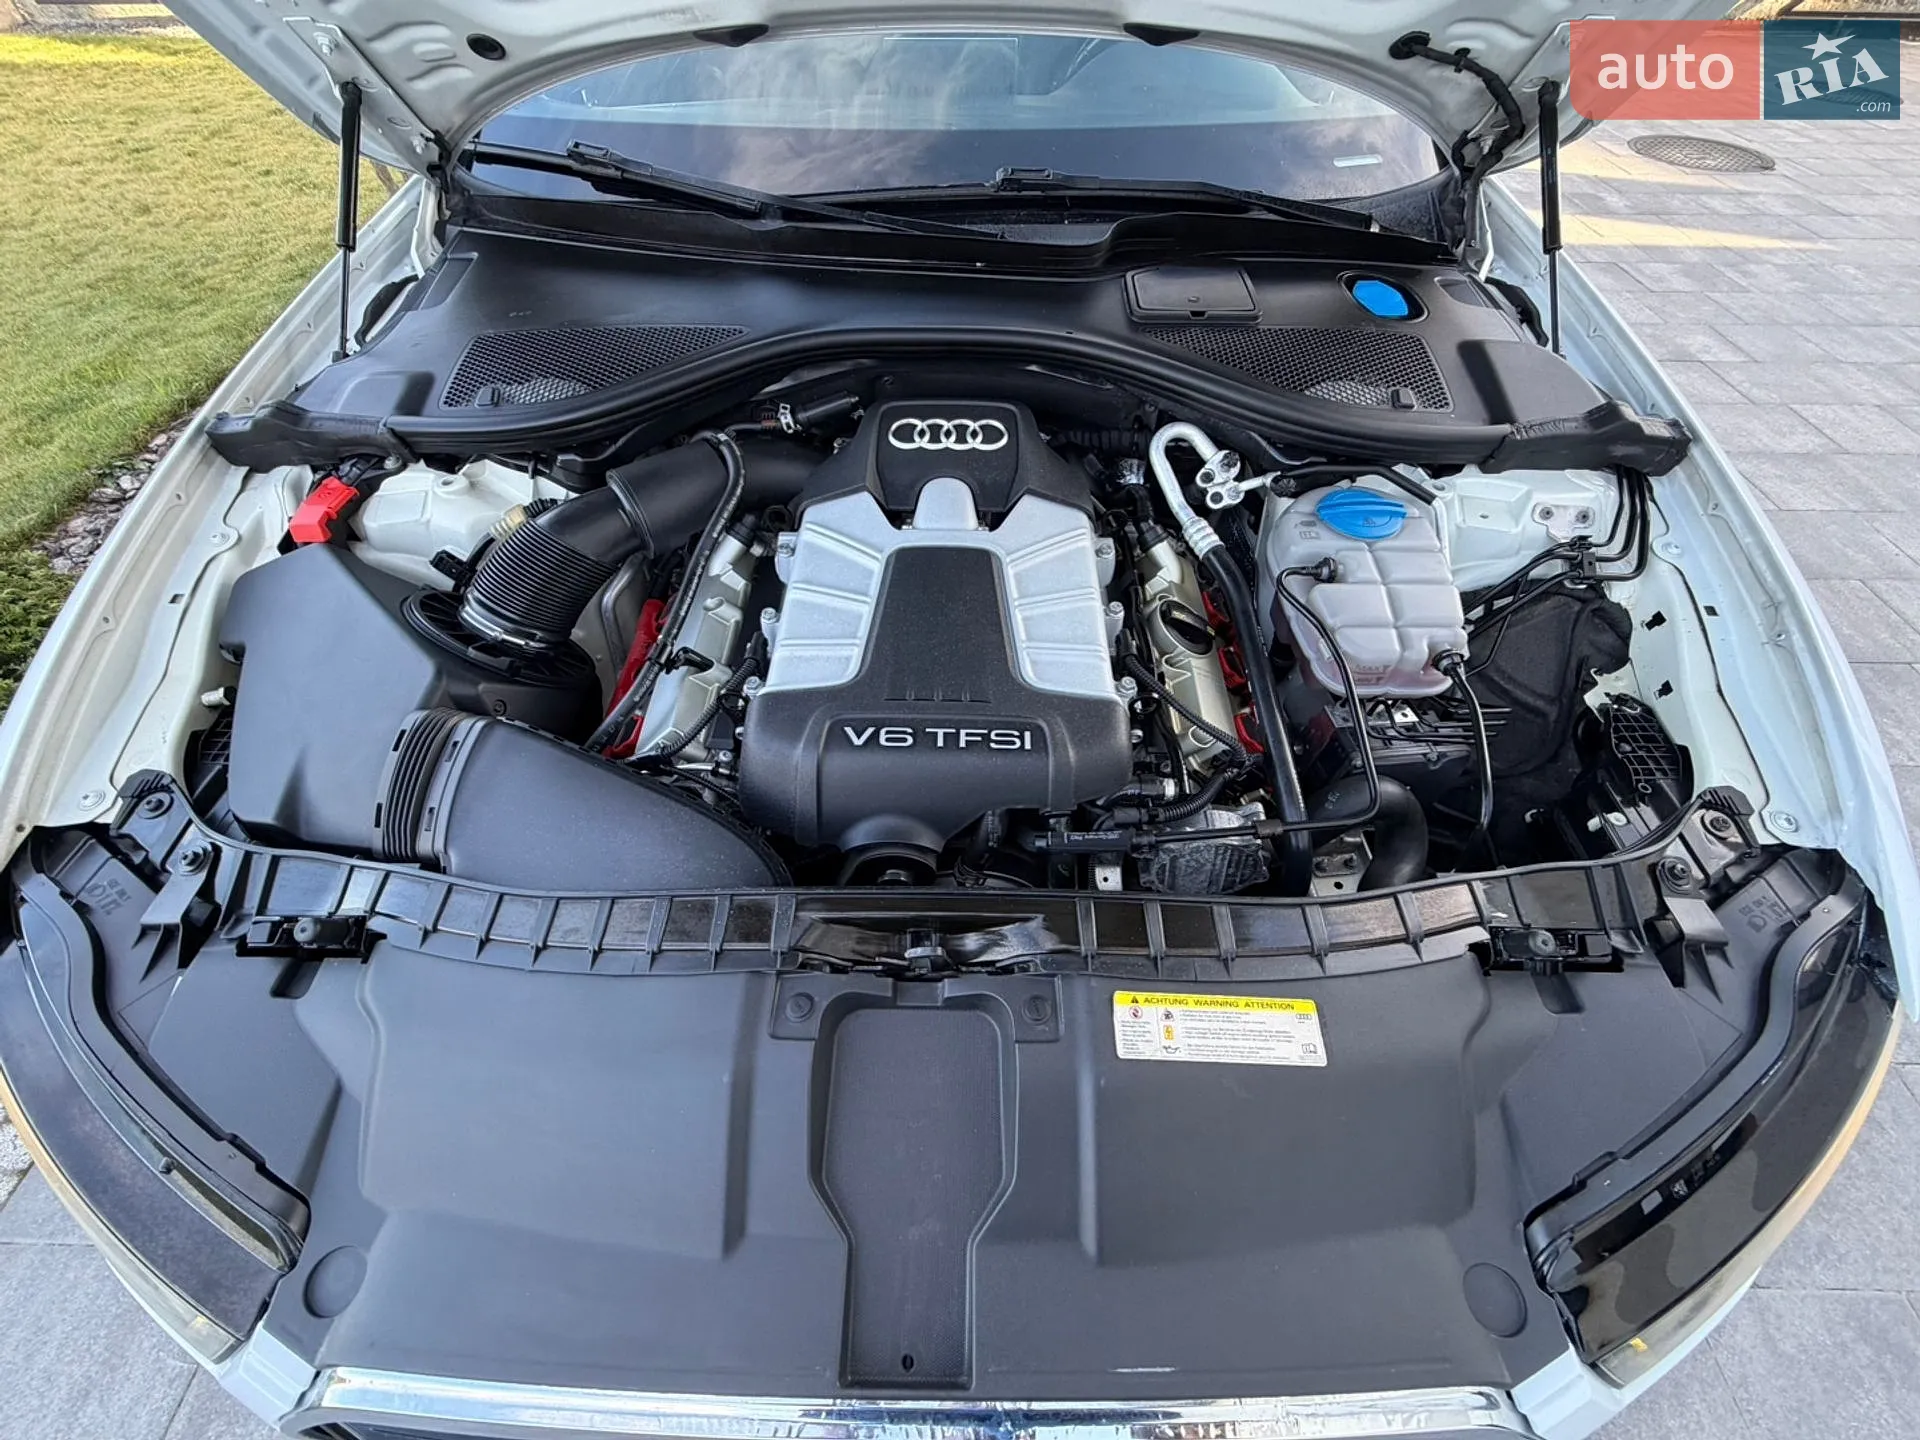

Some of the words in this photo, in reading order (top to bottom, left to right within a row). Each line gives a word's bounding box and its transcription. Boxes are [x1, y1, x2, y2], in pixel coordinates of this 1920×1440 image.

[843, 726, 914, 747] V6
[925, 728, 1032, 750] TFSI
[1143, 997, 1189, 1006] ACHTUNG
[1193, 999, 1239, 1008] WARNING
[1244, 1001, 1295, 1010] ATTENTION
